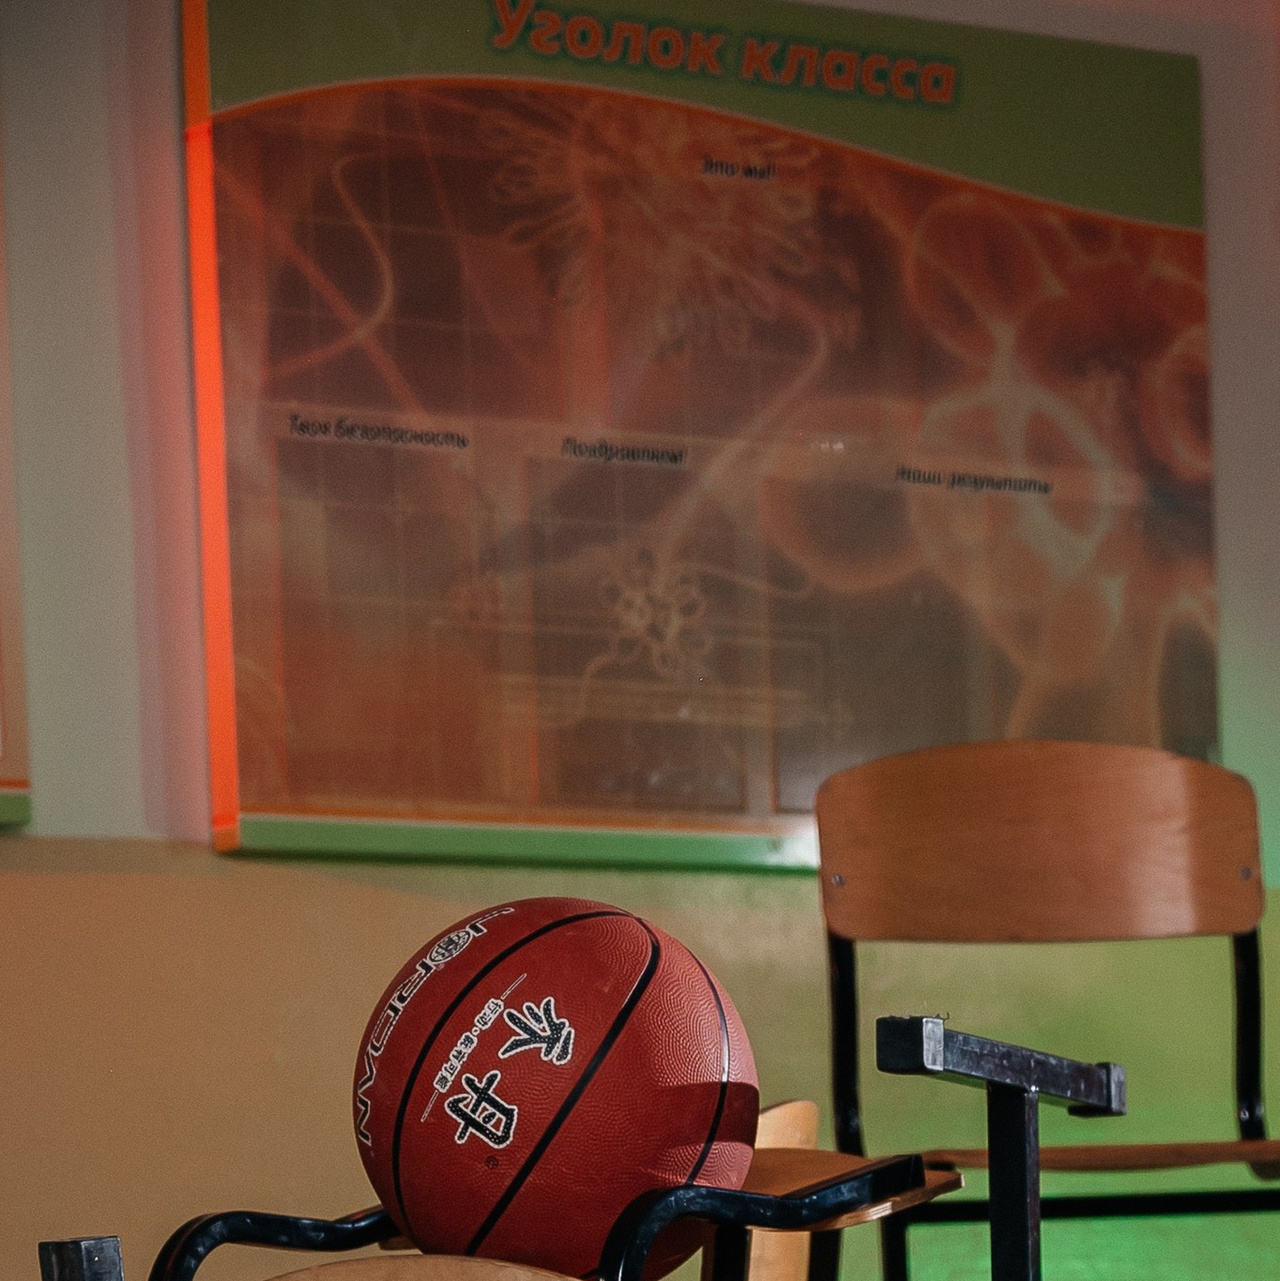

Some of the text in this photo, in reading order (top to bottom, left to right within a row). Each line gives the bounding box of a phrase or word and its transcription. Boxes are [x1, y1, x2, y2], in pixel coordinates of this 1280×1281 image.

[492, 0, 958, 103] Уголок класса
[334, 417, 469, 448] безопасность
[445, 996, 576, 1150] 乔丹
